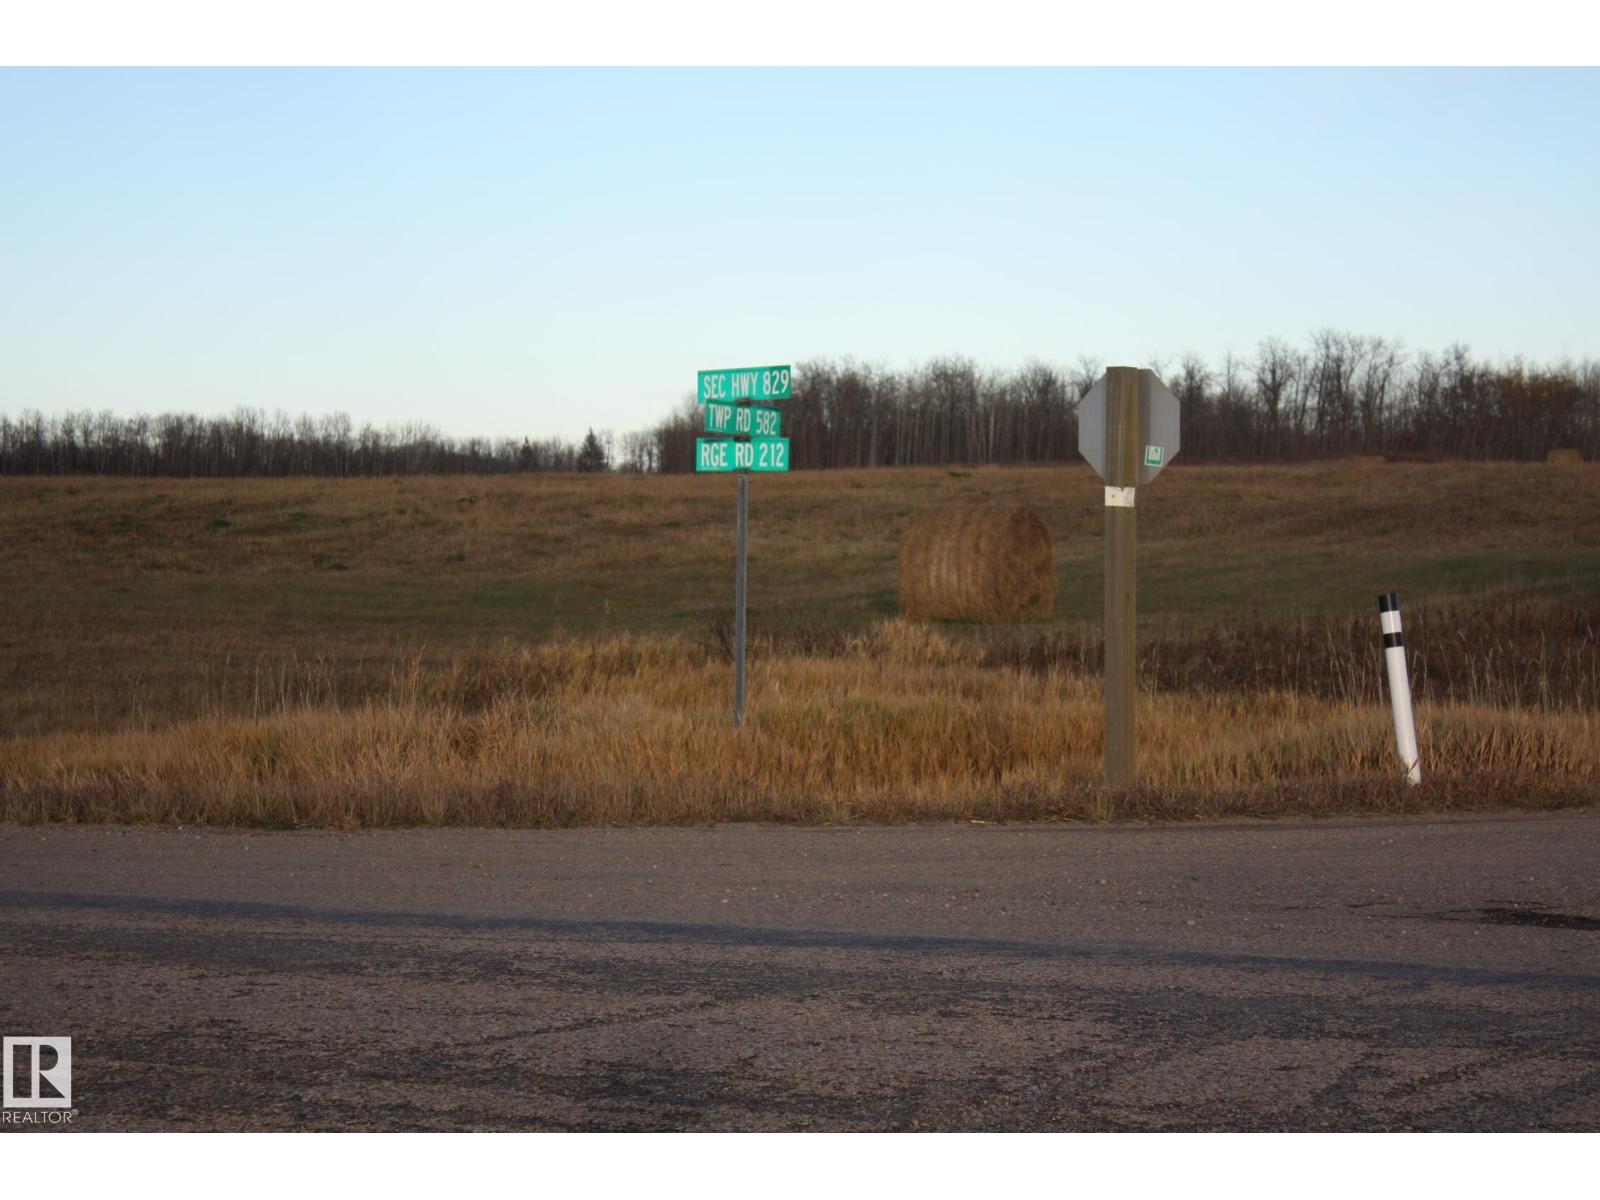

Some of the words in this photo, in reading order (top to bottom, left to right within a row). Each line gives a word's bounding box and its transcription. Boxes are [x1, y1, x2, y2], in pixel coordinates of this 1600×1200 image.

[703, 375, 726, 399] SEC
[731, 372, 758, 397] HWY
[762, 369, 789, 396] 829
[708, 404, 732, 430] TWP
[736, 407, 751, 433] RD
[756, 410, 777, 436] 582
[701, 442, 728, 467] RGE
[735, 442, 754, 467] RD
[759, 442, 784, 467] 212
